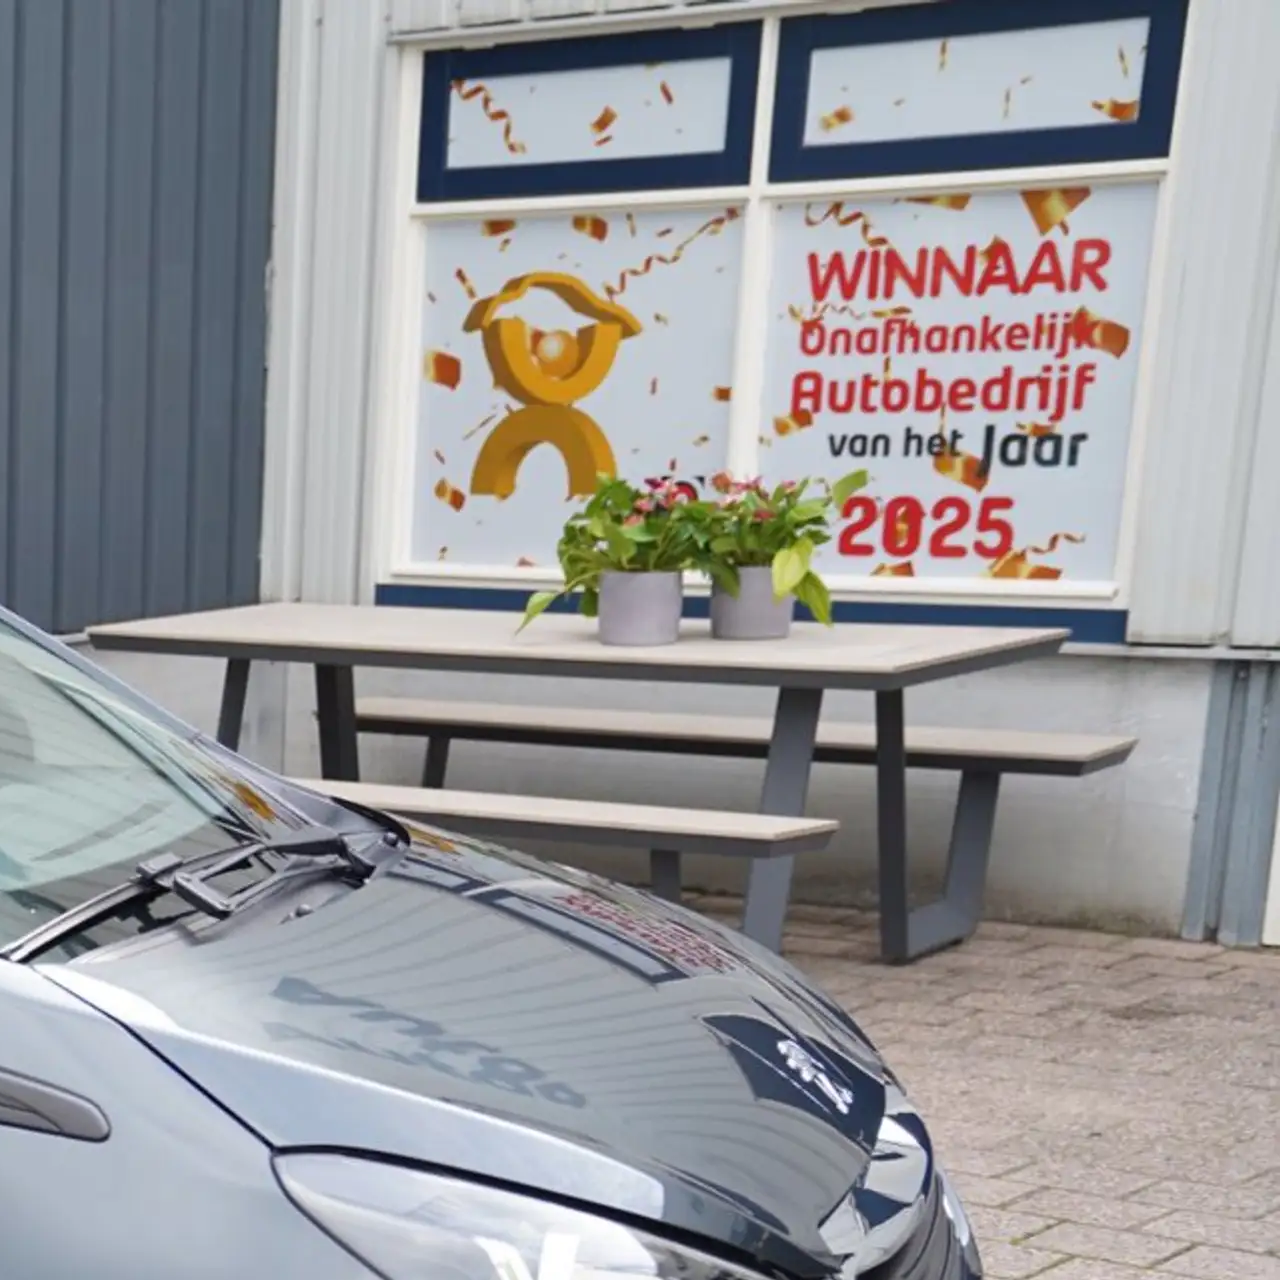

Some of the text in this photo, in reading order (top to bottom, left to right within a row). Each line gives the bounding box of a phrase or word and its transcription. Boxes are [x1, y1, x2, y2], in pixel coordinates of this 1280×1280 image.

[807, 238, 1112, 301] WINNAAR
[799, 312, 1102, 359] Onafhankelijk
[791, 363, 1096, 423] Autobedrijf
[827, 424, 1089, 479] van het Jaar
[836, 496, 1016, 559] 2025
